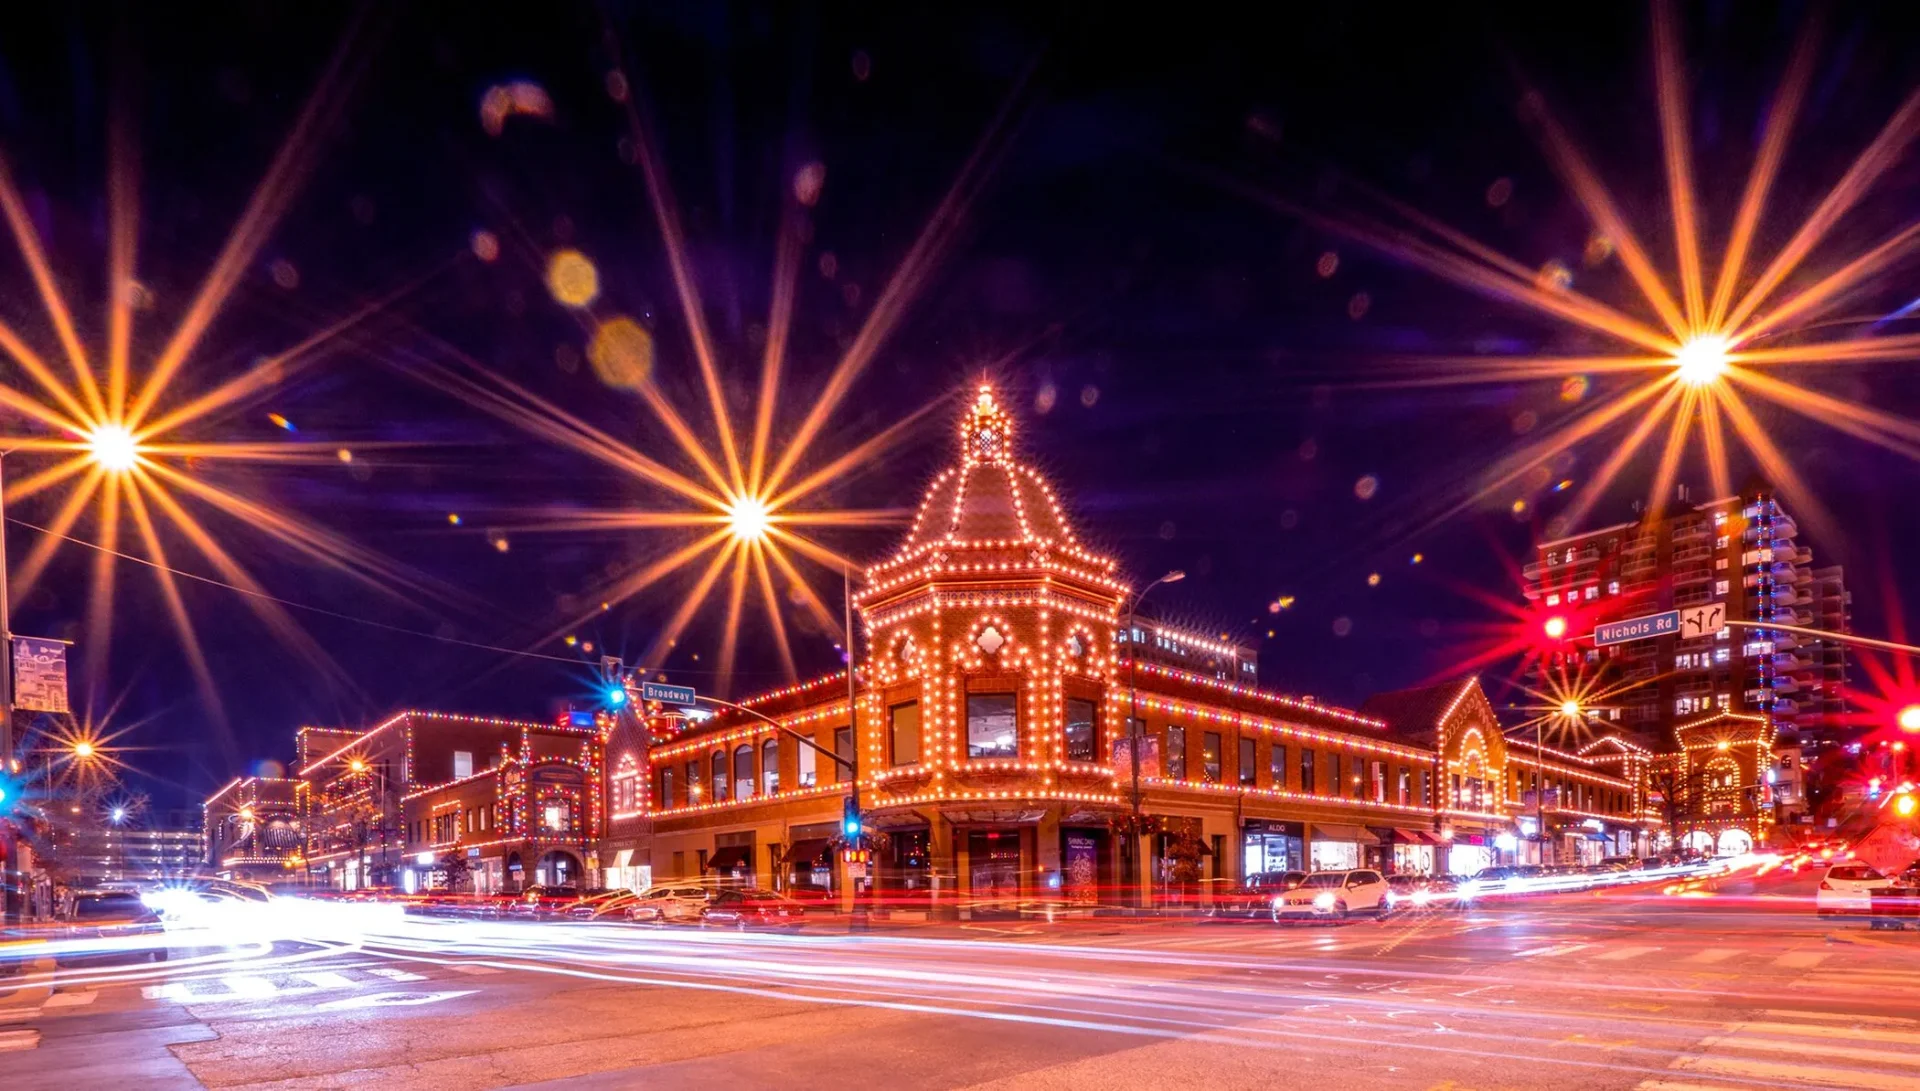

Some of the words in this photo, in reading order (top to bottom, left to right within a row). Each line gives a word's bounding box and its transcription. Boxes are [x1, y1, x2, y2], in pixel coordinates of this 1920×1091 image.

[1602, 622, 1649, 640] Nichols
[1656, 617, 1672, 630] Rd
[648, 687, 690, 702] Broadway
[1268, 824, 1286, 832] ALDO
